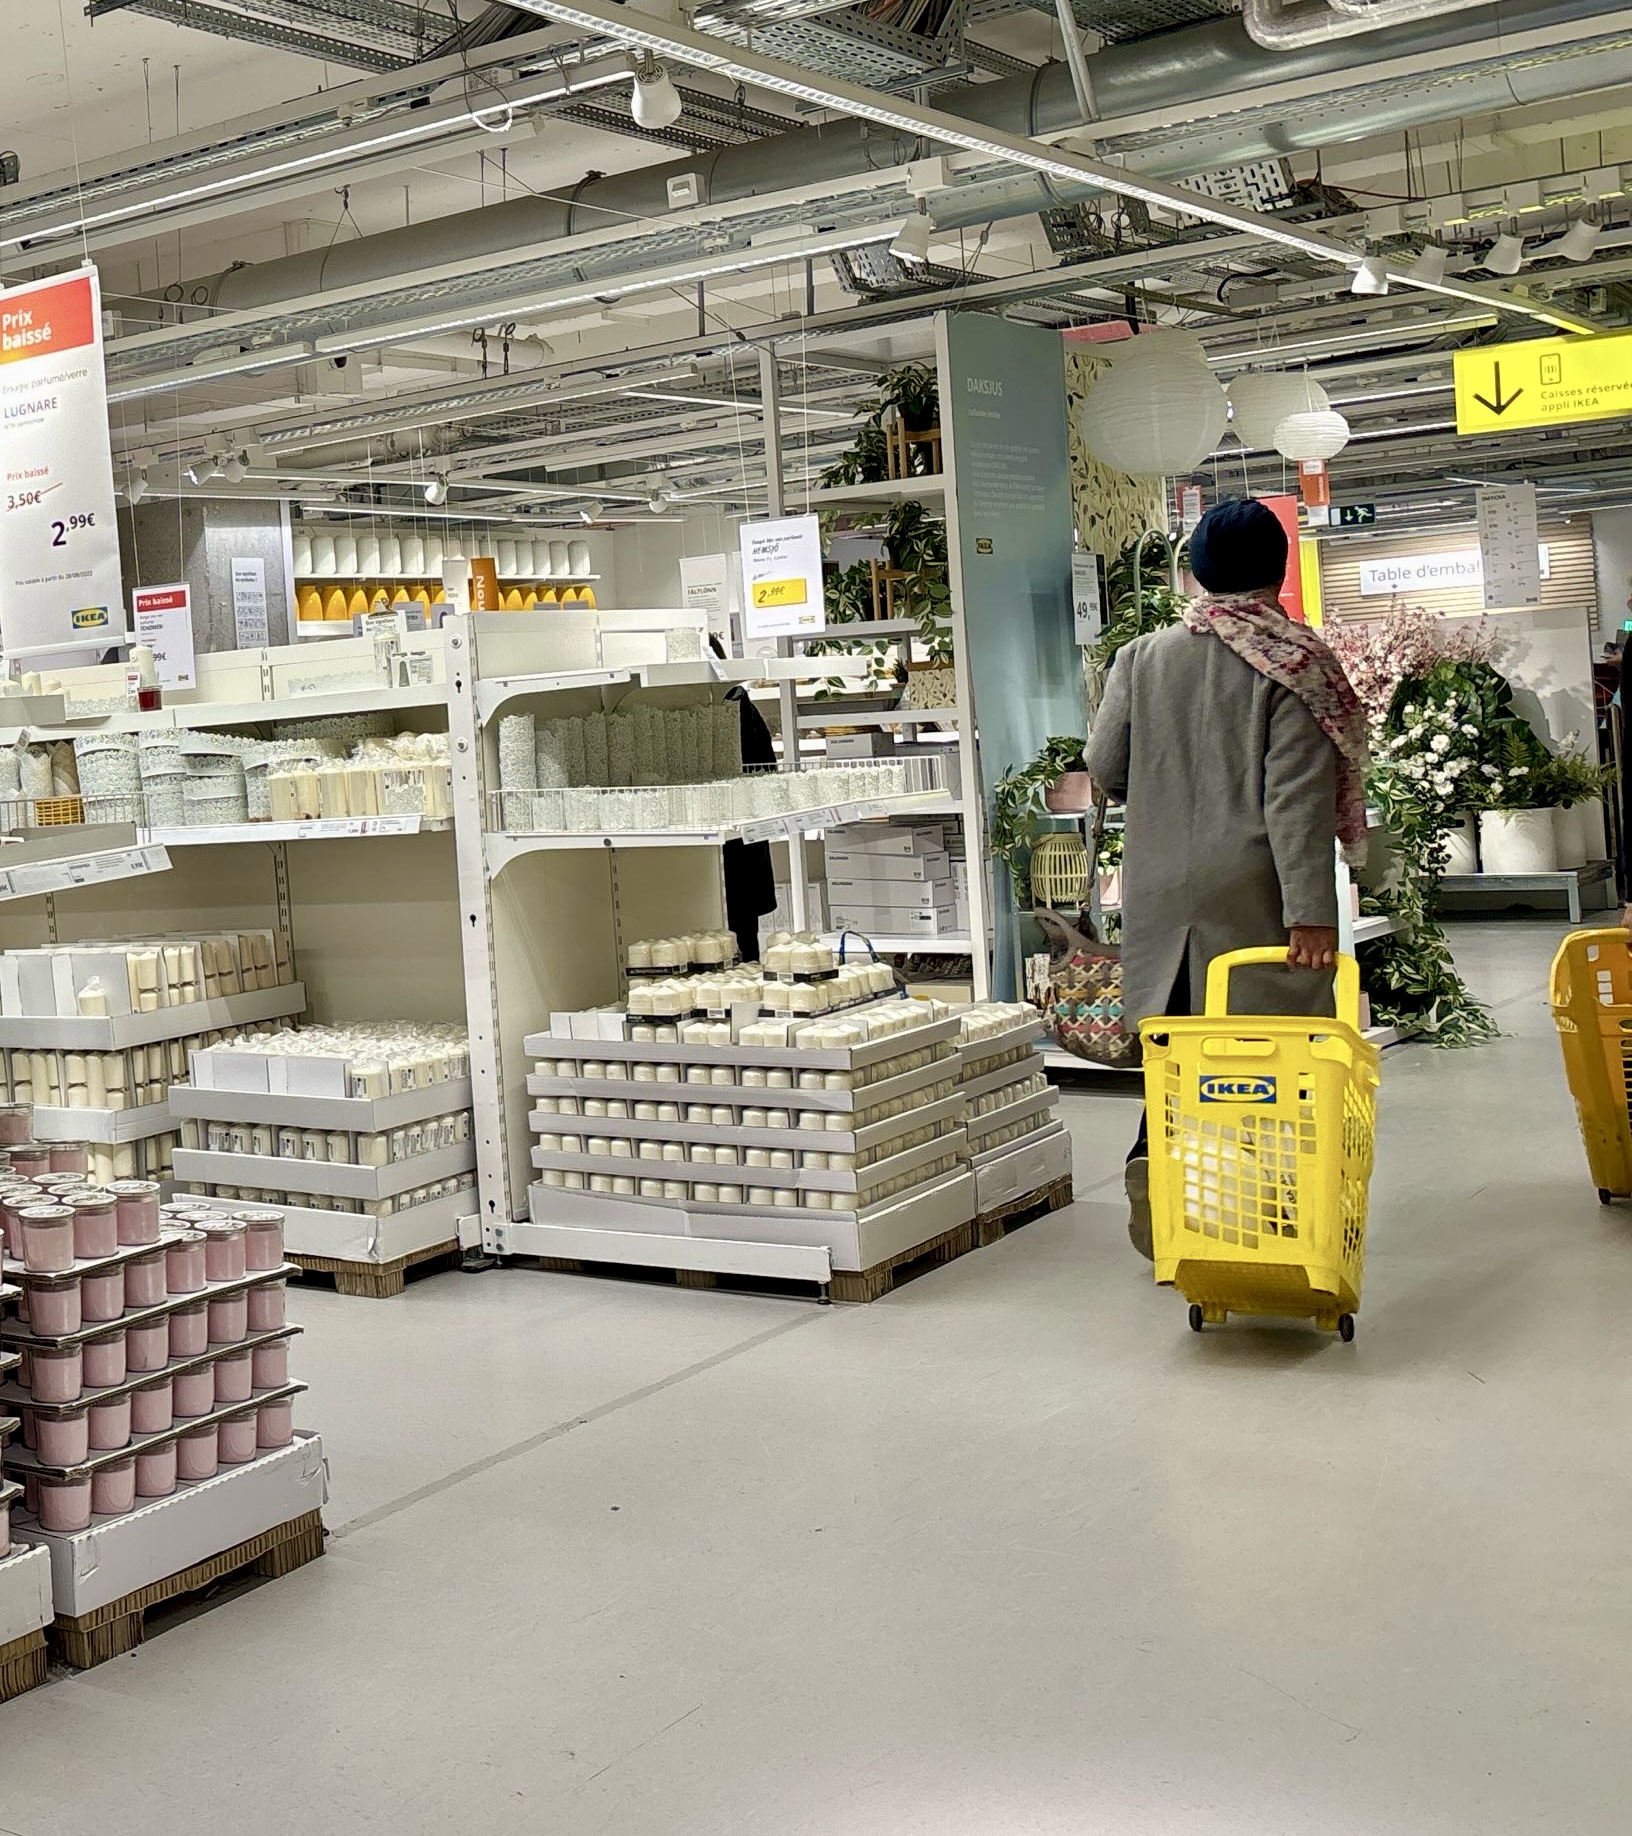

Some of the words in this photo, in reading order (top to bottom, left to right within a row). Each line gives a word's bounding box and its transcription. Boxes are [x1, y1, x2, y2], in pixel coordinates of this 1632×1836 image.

[2, 309, 33, 331] Prix
[2, 322, 52, 351] baissé
[967, 378, 1003, 397] DAKSJUS
[1541, 388, 1583, 400] Caisses
[4, 397, 58, 419] LUGNARE
[1541, 400, 1570, 412] appli
[1573, 397, 1599, 408] IKEA
[7, 470, 23, 481] Prix
[24, 466, 50, 479] baissé
[7, 490, 42, 511] 3,50€
[51, 512, 96, 547] 2,99€
[1369, 566, 1412, 582] Table
[1416, 560, 1480, 579] d'embal
[138, 599, 152, 607] Prix
[152, 596, 174, 605] baissé
[757, 586, 786, 603] 2,99€
[75, 612, 106, 623] IKEA
[1207, 1083, 1269, 1095] IKEA
